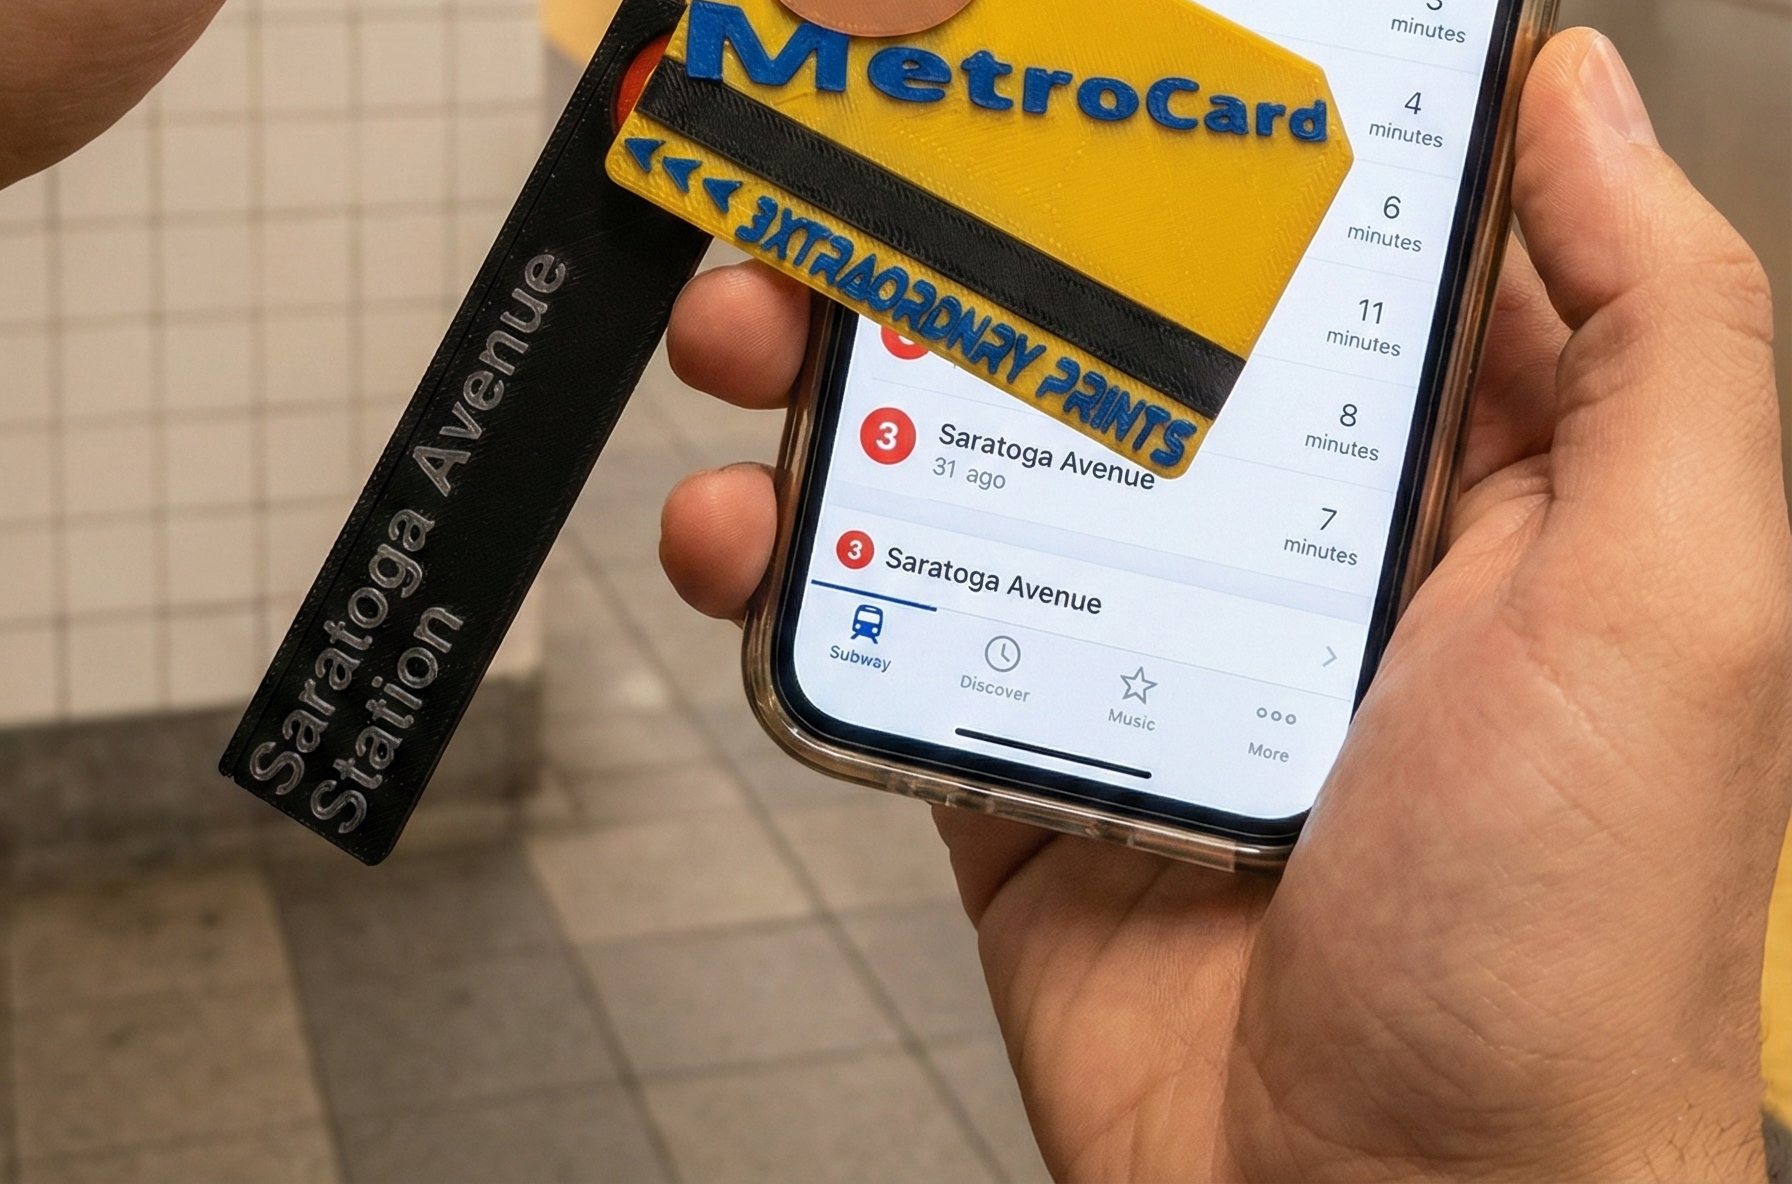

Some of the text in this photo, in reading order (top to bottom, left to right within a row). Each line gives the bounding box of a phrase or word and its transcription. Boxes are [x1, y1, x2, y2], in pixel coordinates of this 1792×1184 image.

[1390, 16, 1467, 44] minutes
[1404, 91, 1422, 115] 4
[1368, 122, 1444, 148] minutes
[1383, 195, 1402, 220] 6
[1347, 225, 1423, 253] minutes
[1358, 298, 1384, 325] 11
[1326, 329, 1402, 357] minutes
[1035, 356, 1197, 469] PRINTS
[1339, 403, 1358, 428] 8
[875, 421, 899, 451] 3
[1304, 433, 1380, 462] minutes
[938, 423, 1156, 491] Saratoga Avenue
[932, 456, 1006, 491] 31 ago
[250, 248, 567, 798] Saratoga Avenue
[1319, 507, 1338, 531] 7
[847, 539, 863, 560] 3
[1283, 538, 1358, 566] minutes
[884, 547, 1102, 615] Saratoga Avenue
[829, 644, 892, 674] Subway
[959, 674, 1032, 703] Discover
[308, 602, 466, 836] Station
[1107, 708, 1156, 732] Music
[1247, 741, 1290, 763] More
